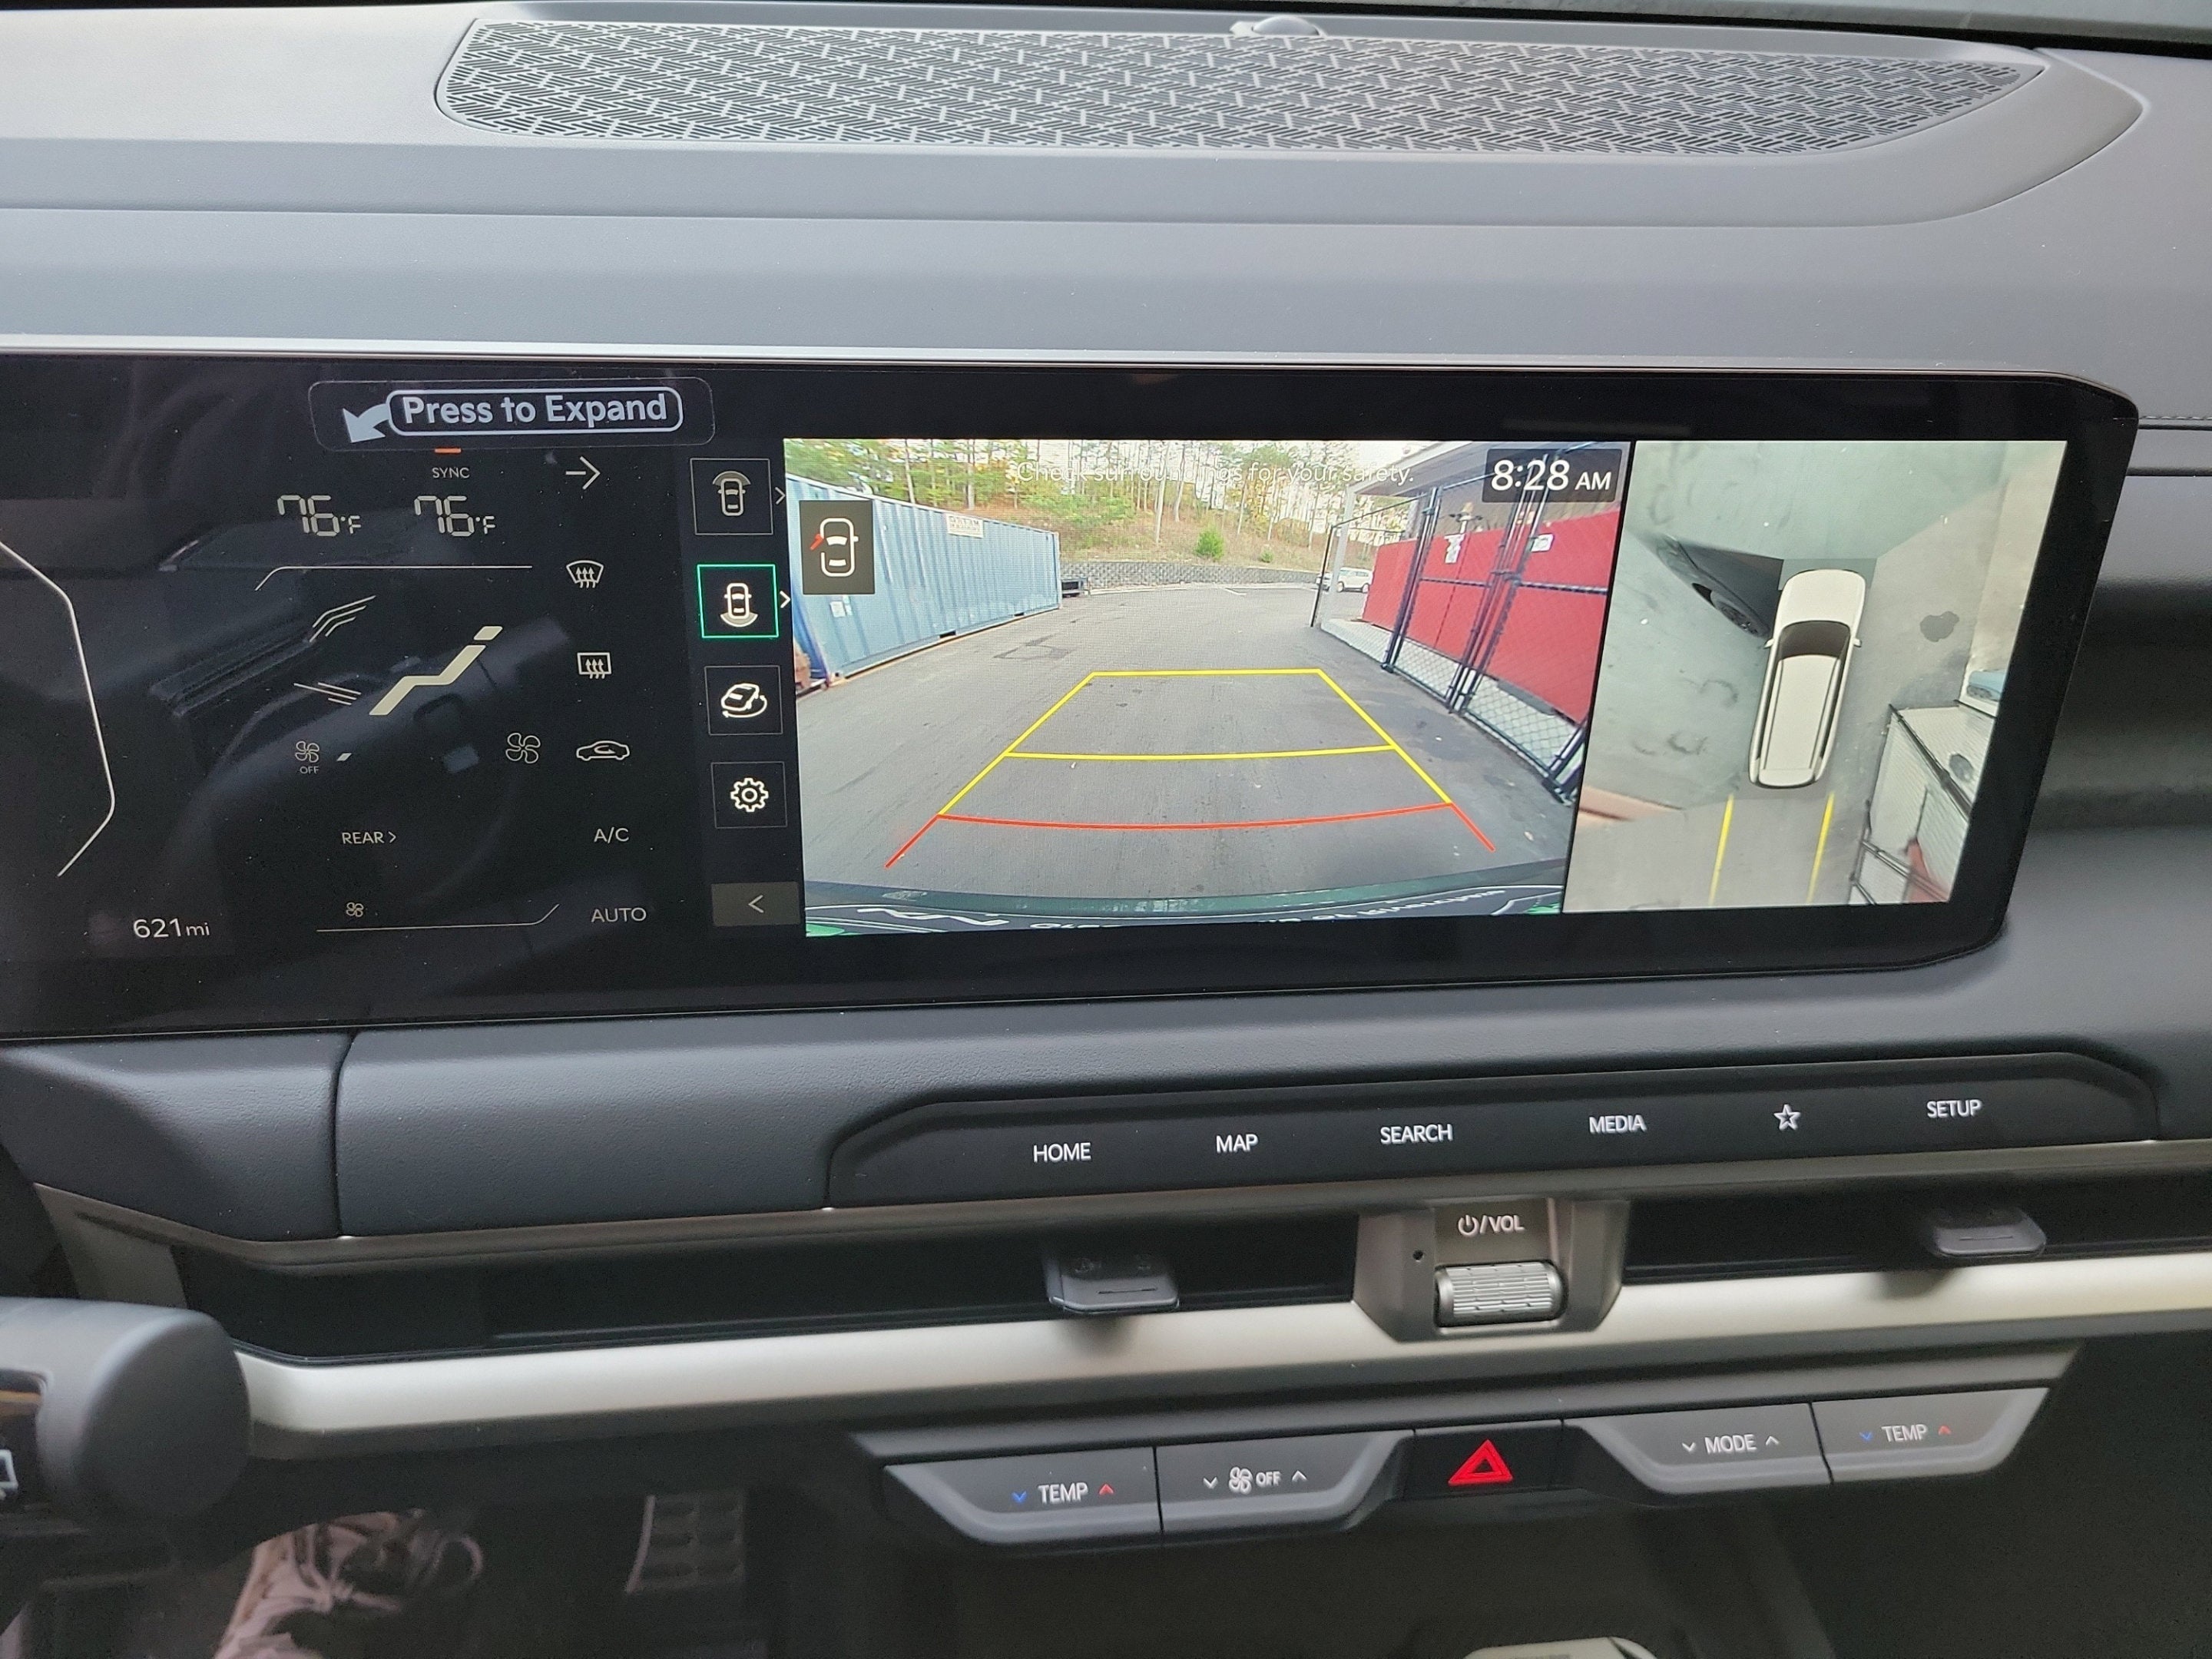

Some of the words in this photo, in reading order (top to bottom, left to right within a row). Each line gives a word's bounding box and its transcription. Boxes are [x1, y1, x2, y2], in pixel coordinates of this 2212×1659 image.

[403, 396, 491, 424] Press
[501, 396, 535, 422] to
[545, 393, 668, 427] Expand
[432, 467, 470, 479] SYNC
[1017, 461, 1088, 482] Check
[1094, 461, 1243, 485] surroundings
[1249, 462, 1283, 482] for
[1287, 466, 1335, 485] your
[1342, 461, 1414, 486] safety.
[1491, 459, 1570, 491] 8:28
[1575, 471, 1611, 490] AM
[300, 766, 320, 774] OFF
[342, 832, 385, 844] REAR
[593, 826, 630, 843] A/C
[591, 907, 647, 922] AUTO
[1926, 1099, 1982, 1118] SETUP
[1588, 1114, 1647, 1134] MEDIA
[1215, 1134, 1259, 1153] MAP
[1379, 1124, 1453, 1144] SEARCH
[1032, 1142, 1091, 1162] HOME
[1881, 1424, 1928, 1442] TEMP
[1704, 1433, 1757, 1454] MODE
[1256, 1471, 1281, 1487] OFF
[1038, 1482, 1088, 1504] TEMP
